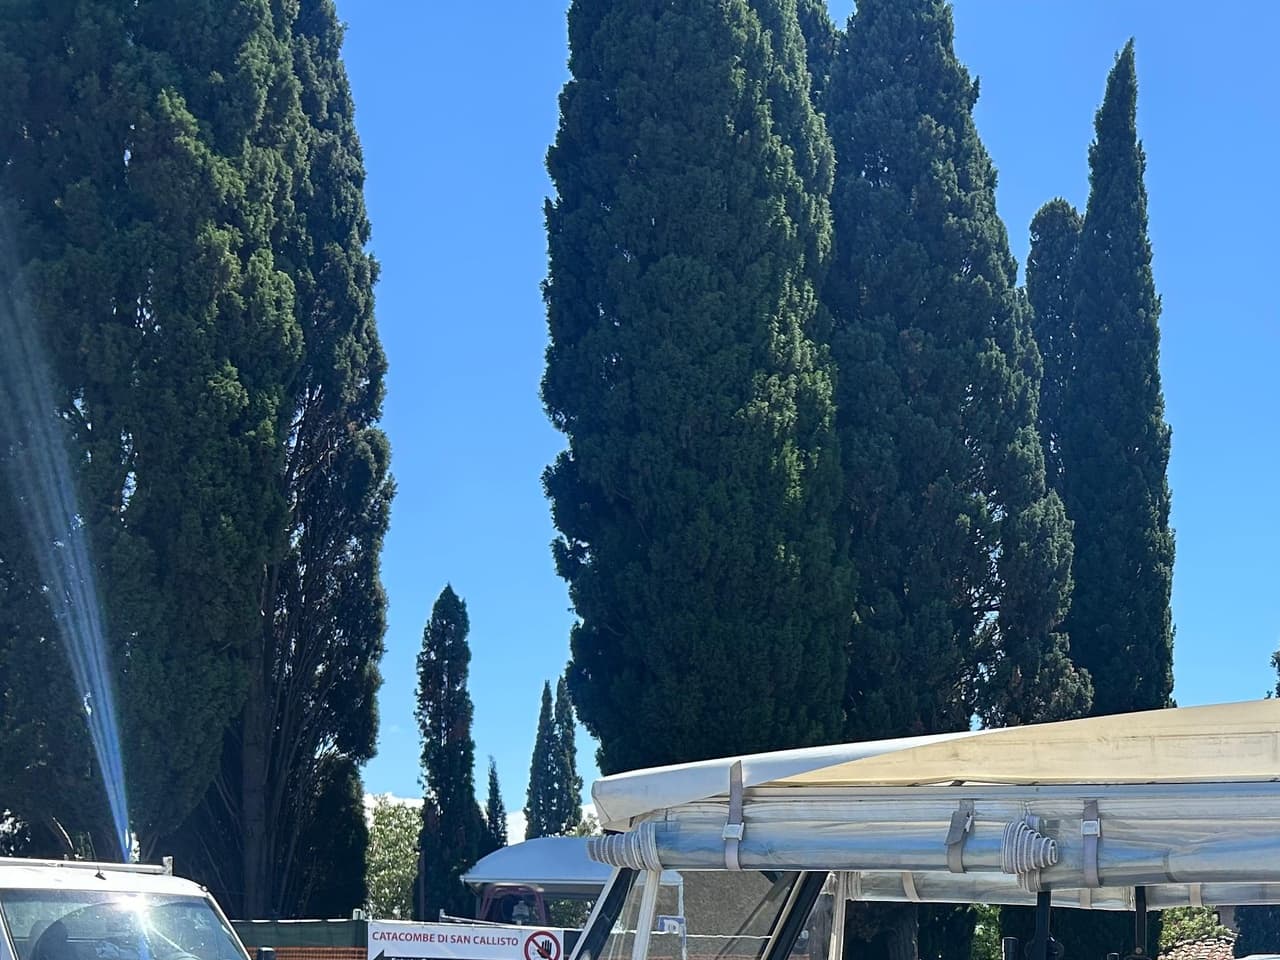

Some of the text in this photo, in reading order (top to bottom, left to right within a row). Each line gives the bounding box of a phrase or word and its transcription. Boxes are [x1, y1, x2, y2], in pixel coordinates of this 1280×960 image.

[372, 931, 519, 946] CATACOMBE DI SAN CALLISTO
